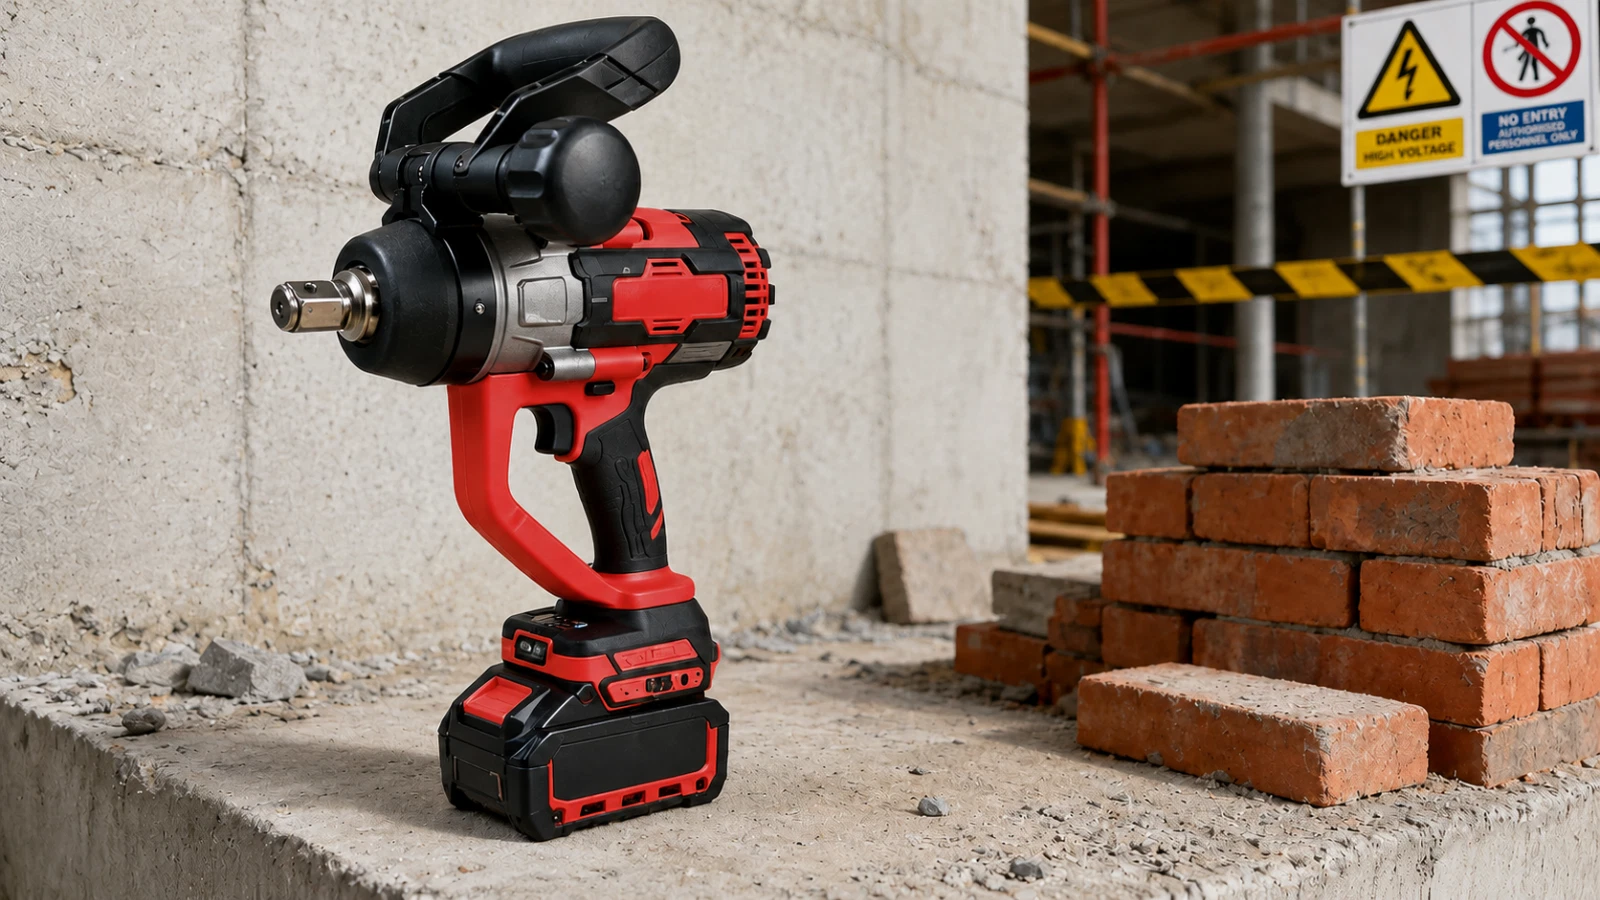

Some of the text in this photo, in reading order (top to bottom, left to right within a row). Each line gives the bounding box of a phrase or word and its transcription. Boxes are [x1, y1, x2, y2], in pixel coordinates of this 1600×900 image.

[1498, 107, 1567, 127] NO ENTRY
[1376, 126, 1442, 145] DANGER
[1550, 130, 1578, 143] ONLY
[1363, 141, 1456, 163] HIGH VOLTAGE
